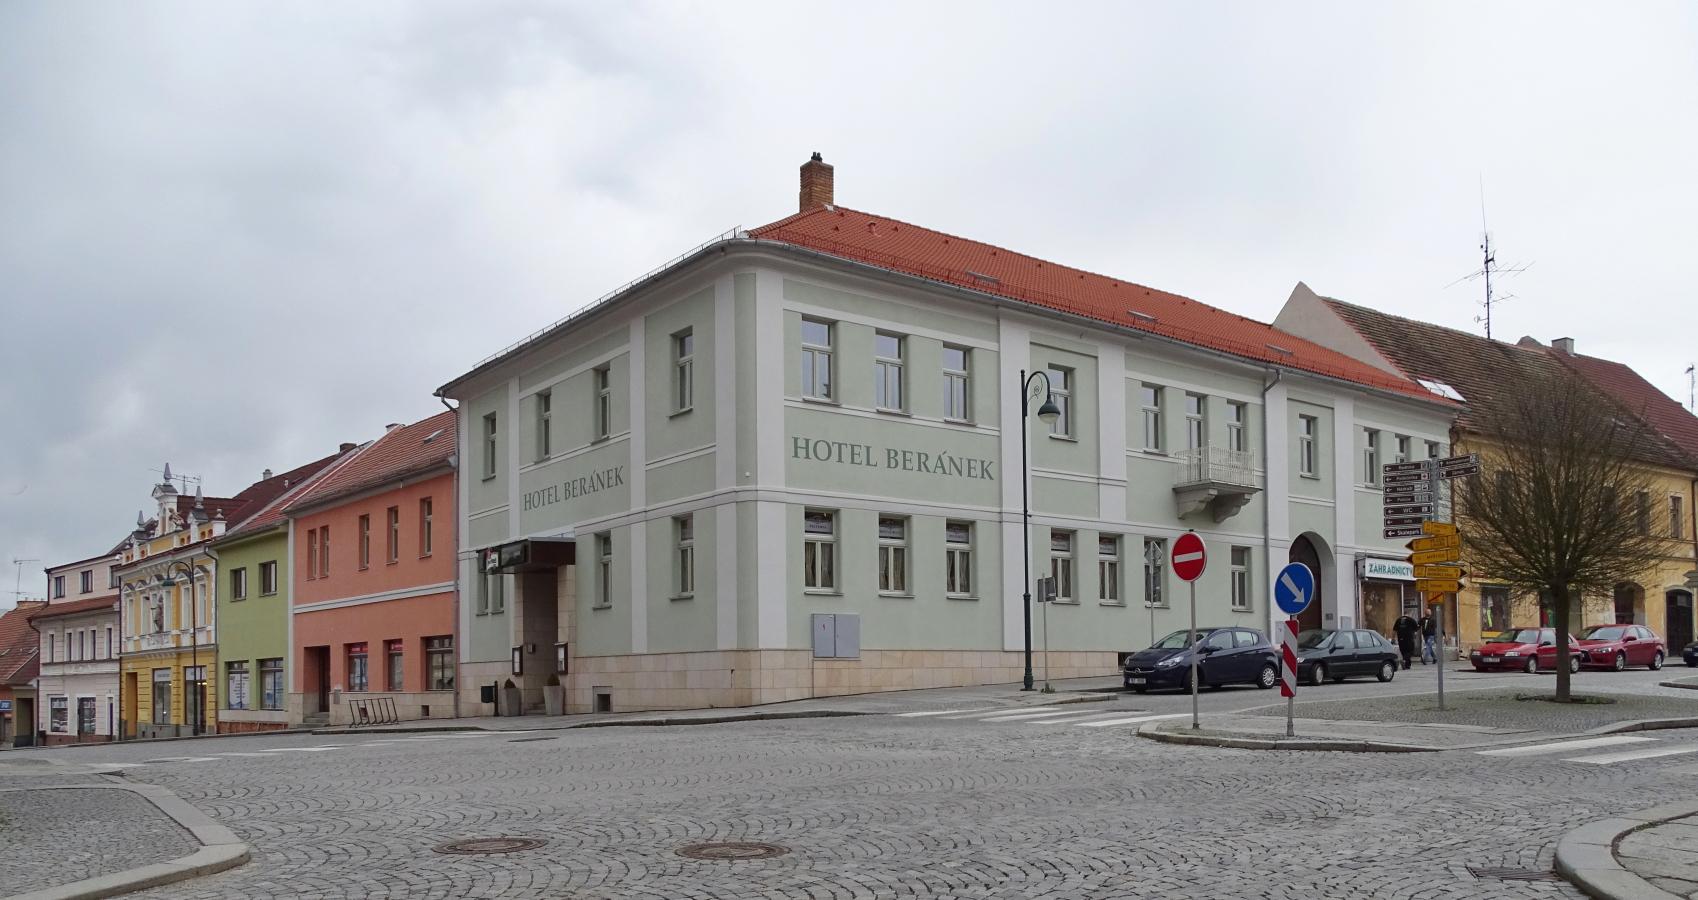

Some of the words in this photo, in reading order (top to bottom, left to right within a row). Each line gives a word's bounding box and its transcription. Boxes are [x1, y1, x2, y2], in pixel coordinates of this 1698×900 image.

[792, 436, 878, 467] HOTEL
[885, 448, 994, 481] BERÁNEK
[523, 485, 561, 511] HOTEL
[564, 465, 624, 501] BERÁNEK
